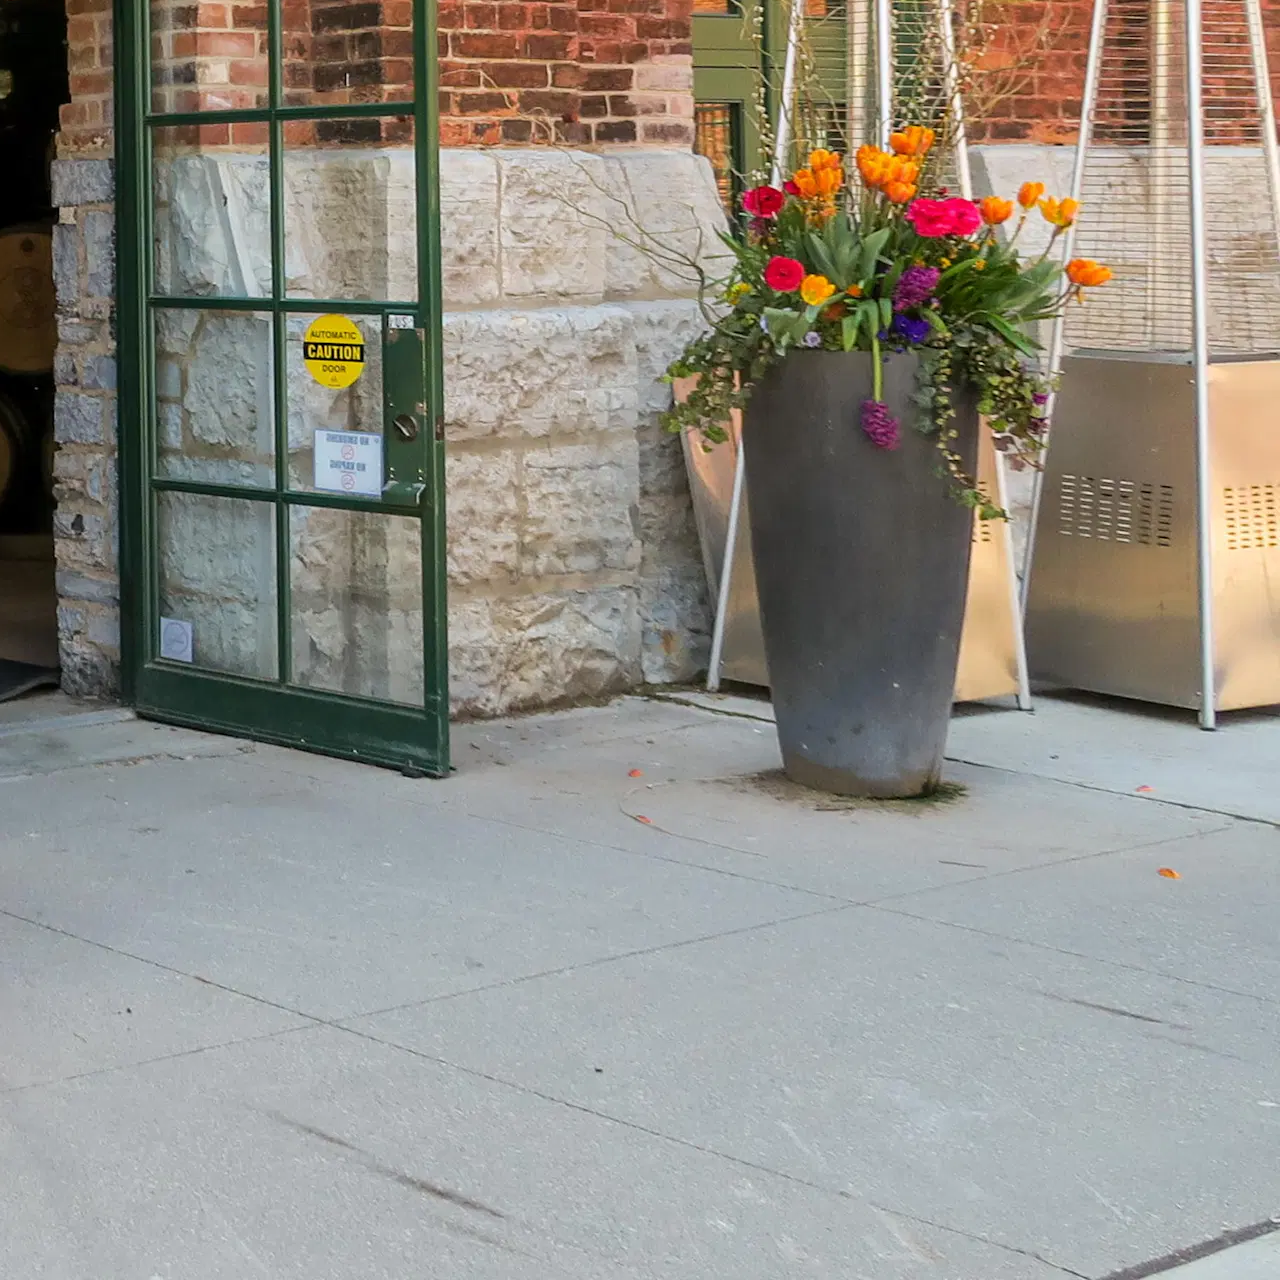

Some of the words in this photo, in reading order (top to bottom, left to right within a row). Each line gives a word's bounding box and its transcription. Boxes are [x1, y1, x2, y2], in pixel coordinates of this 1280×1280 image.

[311, 331, 357, 340] AUTOMATIC
[307, 344, 361, 360] CAUTION
[322, 364, 347, 373] DOOR
